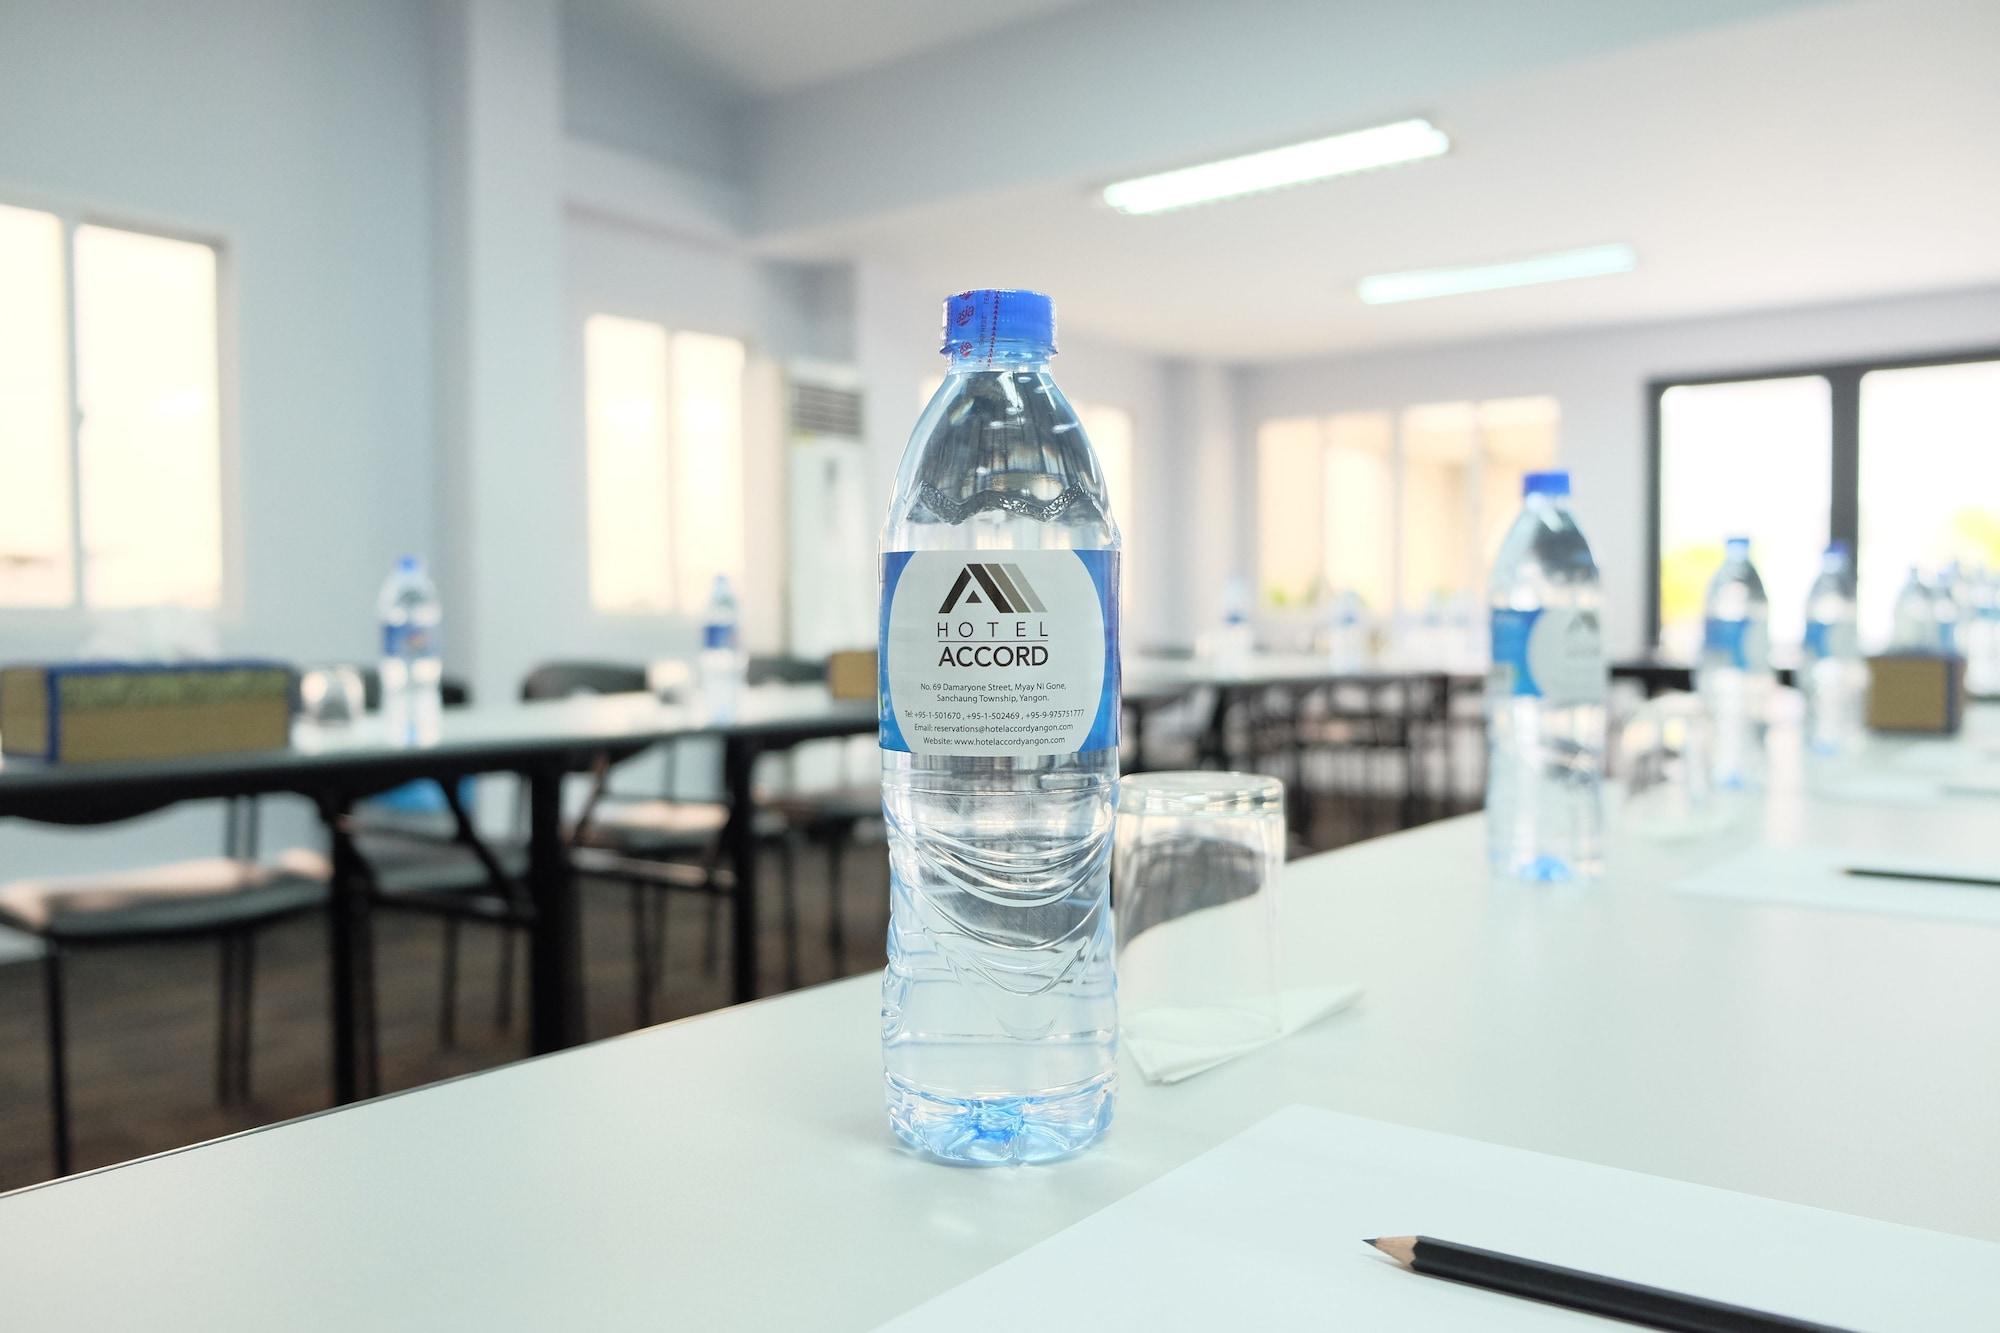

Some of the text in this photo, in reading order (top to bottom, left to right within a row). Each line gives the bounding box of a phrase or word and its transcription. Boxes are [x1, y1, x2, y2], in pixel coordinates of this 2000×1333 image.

[937, 622, 1048, 637] HOTEL
[938, 646, 1048, 666] ACCORD
[943, 684, 986, 692] Damaryone
[988, 683, 1012, 691] Street,
[1015, 683, 1034, 692] Myay
[937, 695, 977, 703] Sanchaung
[979, 695, 1017, 703] Township,
[934, 724, 1073, 733] reservations@hotelaccordyangon.com
[954, 737, 1065, 746] www.hotelaccordyangon.com
